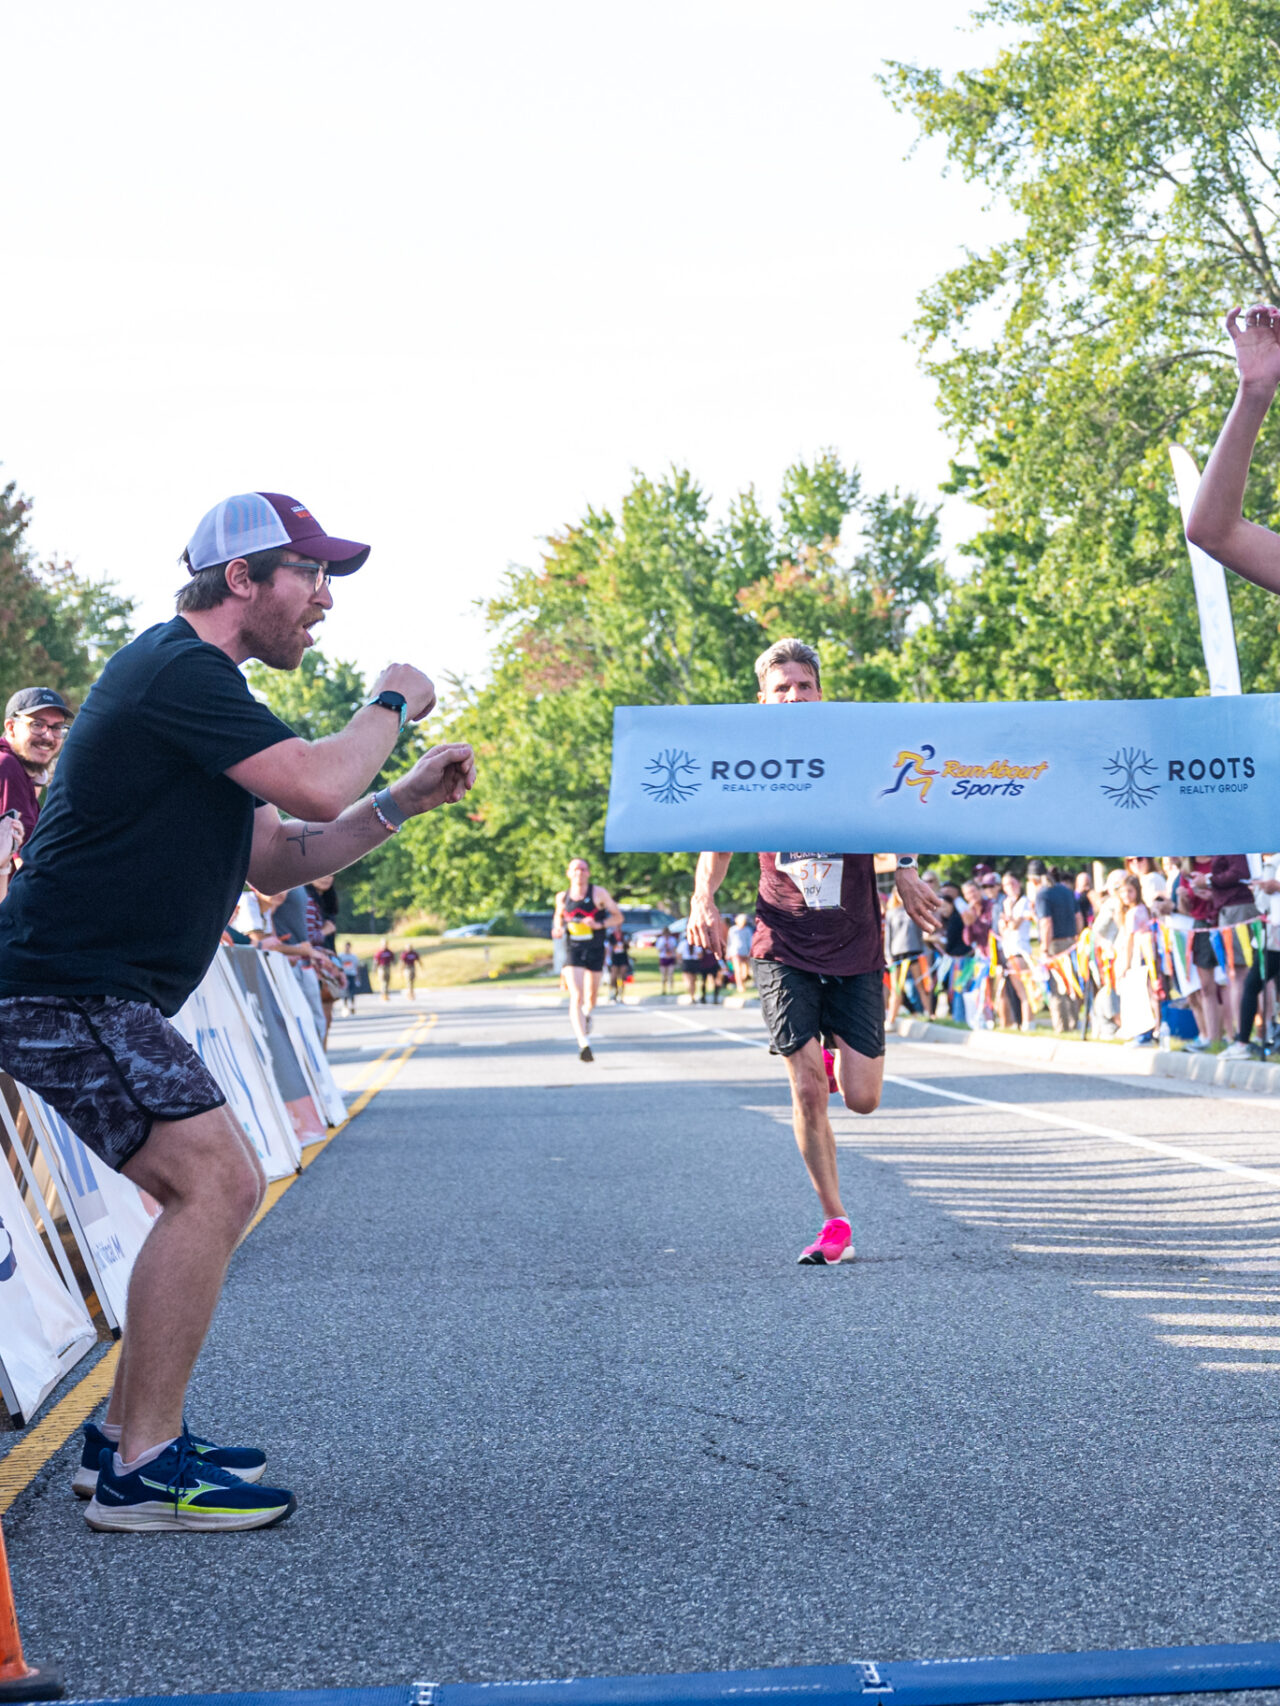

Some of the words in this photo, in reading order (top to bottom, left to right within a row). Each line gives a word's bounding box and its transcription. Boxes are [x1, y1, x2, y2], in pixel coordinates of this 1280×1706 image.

[711, 758, 825, 780] ROOTS
[941, 759, 1049, 781] RunAbout
[1168, 756, 1256, 781] ROOTS
[722, 783, 767, 792] REALTY
[770, 783, 813, 792] GROUP
[951, 779, 1025, 799] Sports
[1179, 784, 1216, 795] REALTY
[1218, 783, 1249, 793] GROUP
